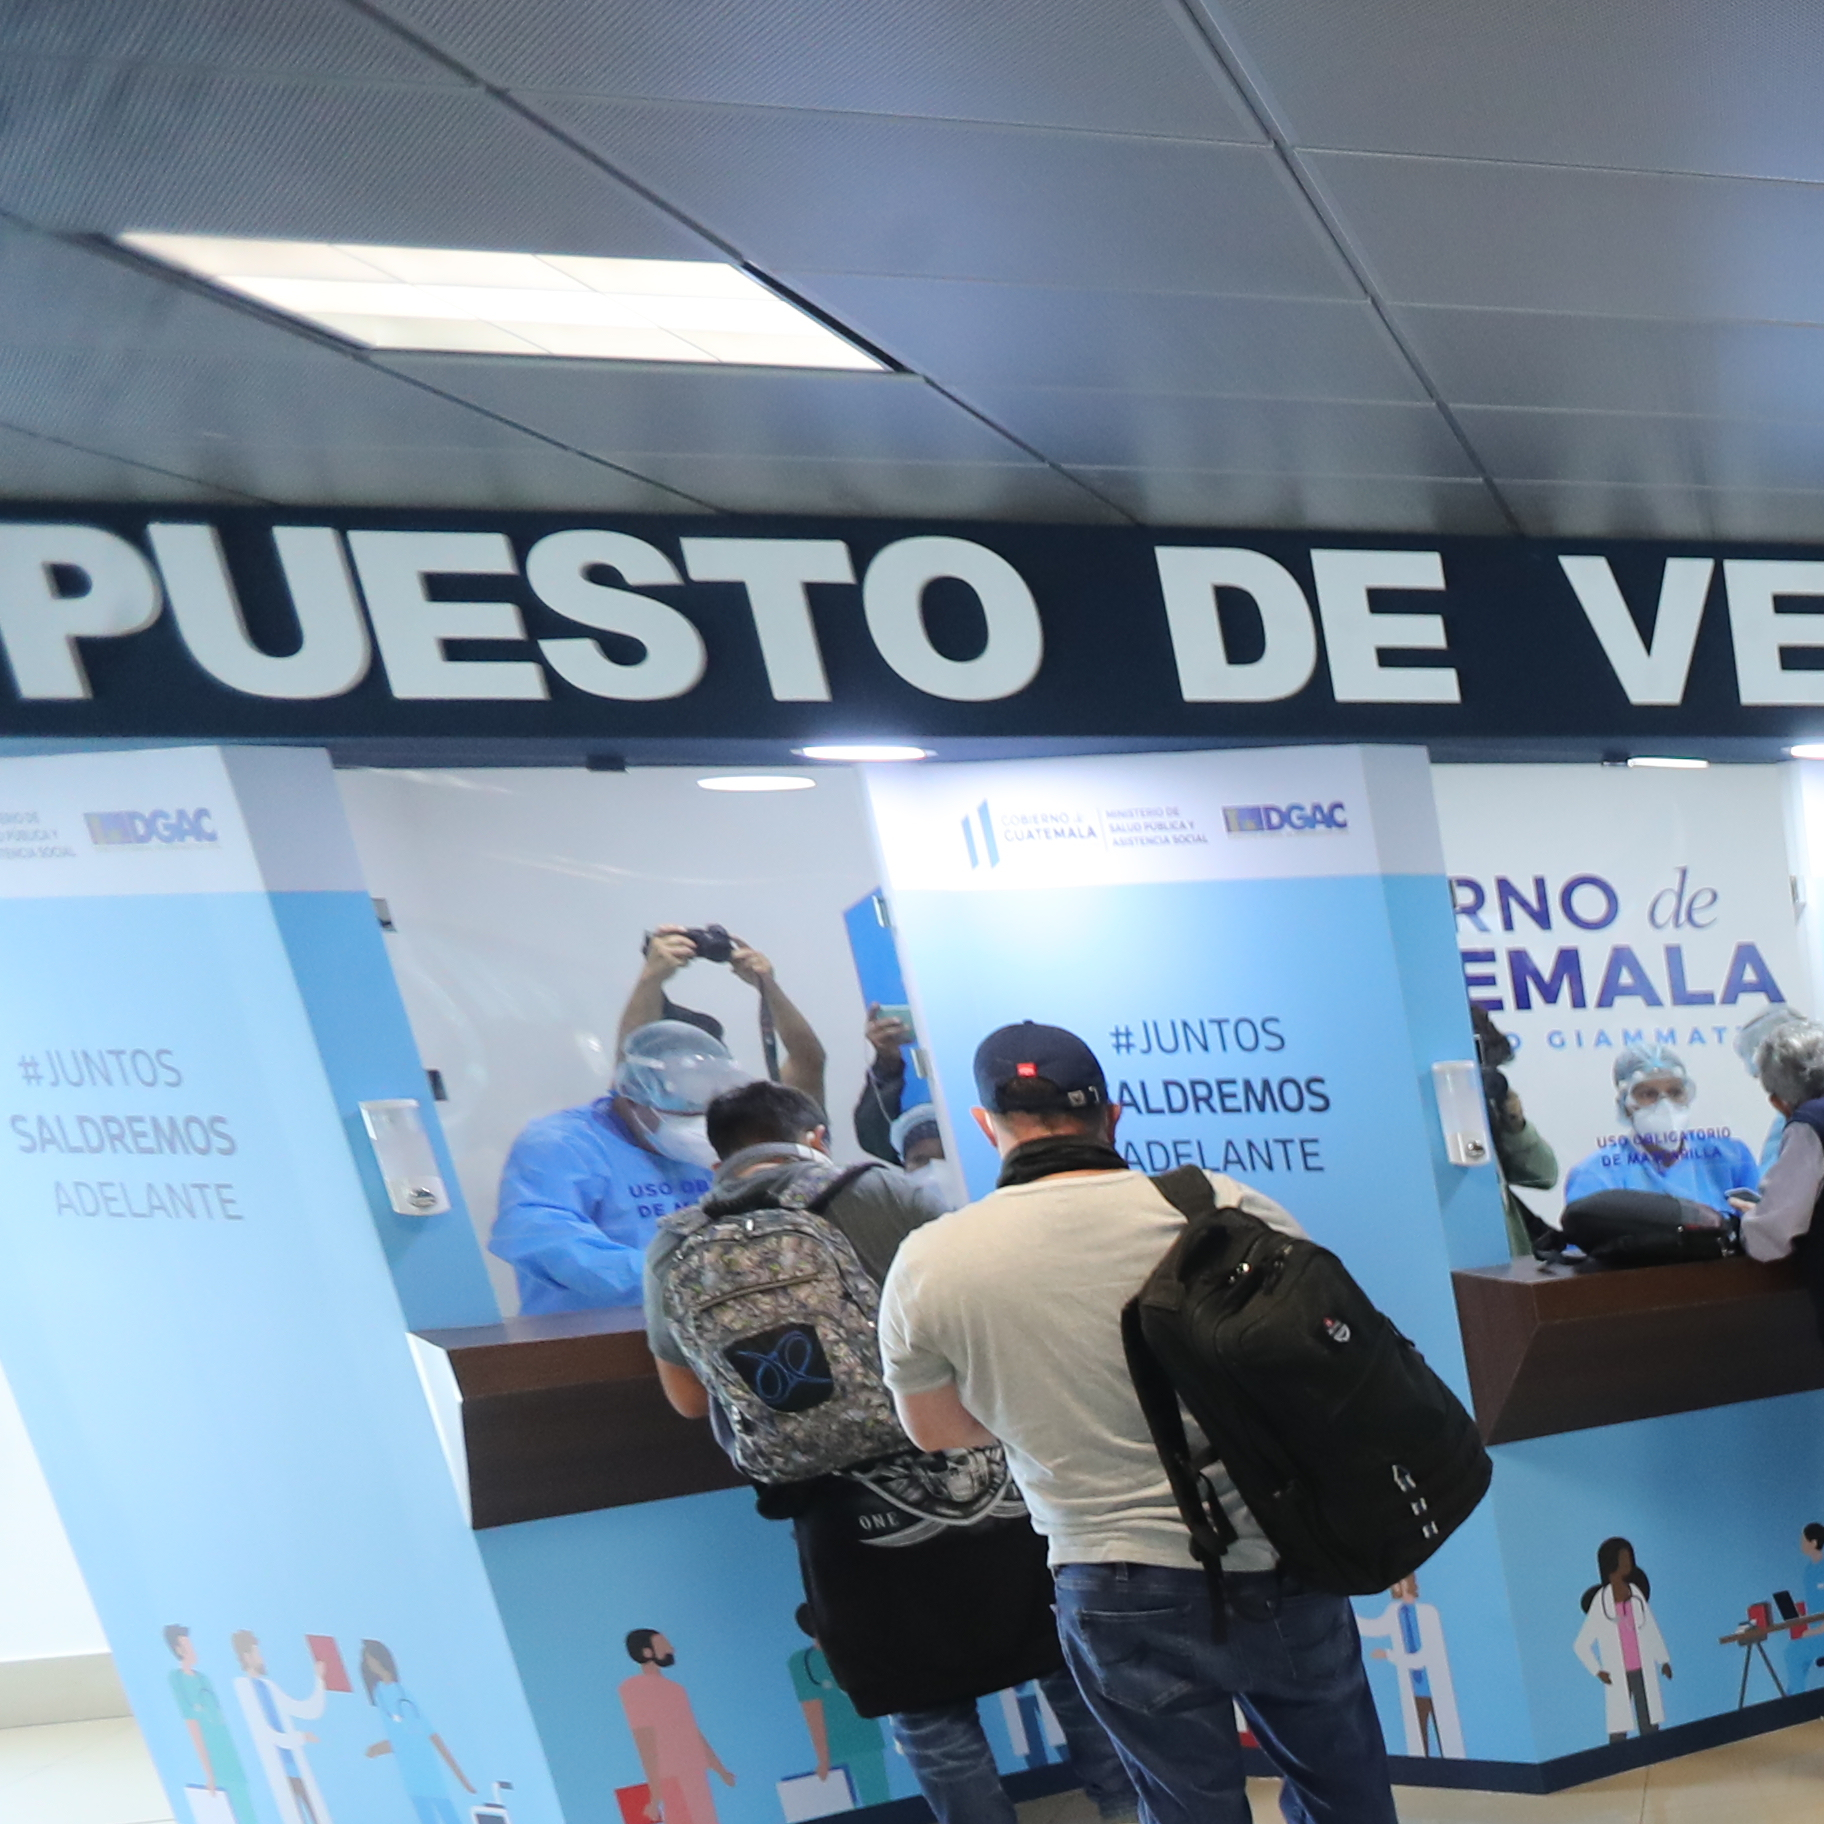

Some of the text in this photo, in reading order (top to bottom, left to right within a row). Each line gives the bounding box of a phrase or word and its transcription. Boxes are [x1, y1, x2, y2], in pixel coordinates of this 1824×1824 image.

[0, 522, 1043, 702] PUESTO
[1155, 546, 1462, 704] DE
[133, 807, 218, 844] DGAC
[1263, 800, 1348, 831] DGAC
[1647, 865, 1719, 931] de
[1109, 1015, 1287, 1055] #JUNTOS
[1547, 1026, 1742, 1049] GIAMMAT
[17, 1047, 183, 1088] #JUNTOS
[1117, 1076, 1332, 1116] ALDREMOS
[8, 1113, 239, 1157] SALDREMOS
[1596, 1126, 1731, 1149] USO OBLIGATORIO
[1124, 1137, 1325, 1173] ADELANTE
[1601, 1153, 1621, 1167] DE
[53, 1180, 245, 1221] ADELANTE
[629, 1182, 674, 1198] USO
[638, 1203, 666, 1218] DE
[858, 1511, 899, 1530] ONE
